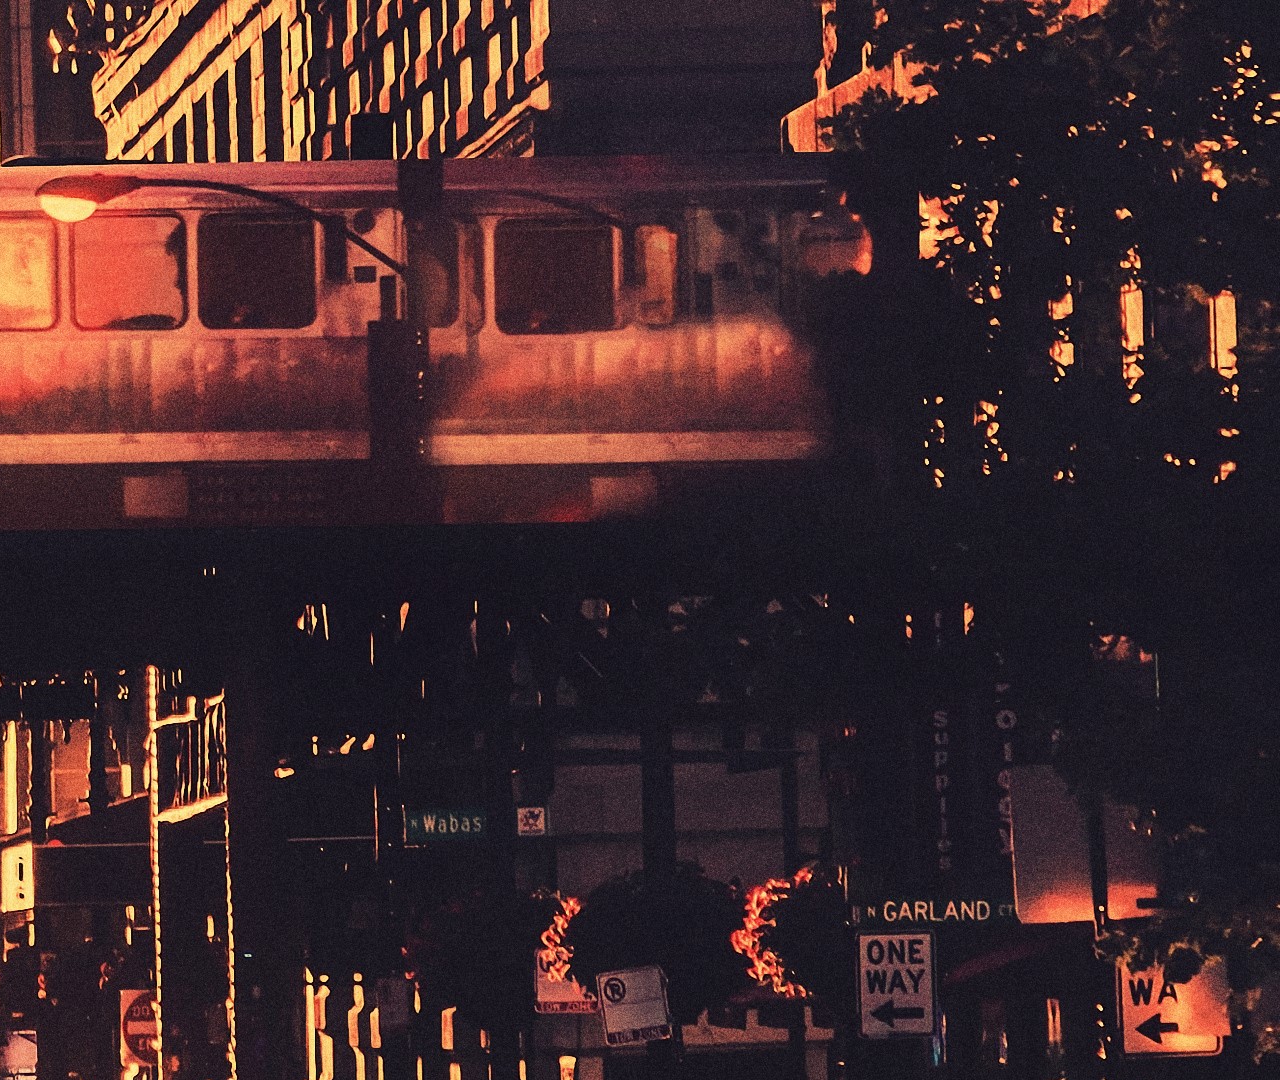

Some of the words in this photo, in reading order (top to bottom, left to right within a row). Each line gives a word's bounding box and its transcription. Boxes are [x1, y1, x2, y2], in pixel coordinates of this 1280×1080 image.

[423, 813, 483, 833] Wabas
[866, 906, 877, 918] N
[883, 900, 991, 922] GARLAND
[998, 904, 1014, 917] CT
[866, 939, 925, 965] ONE
[865, 969, 926, 995] WAY
[1128, 979, 1178, 1006] WA
